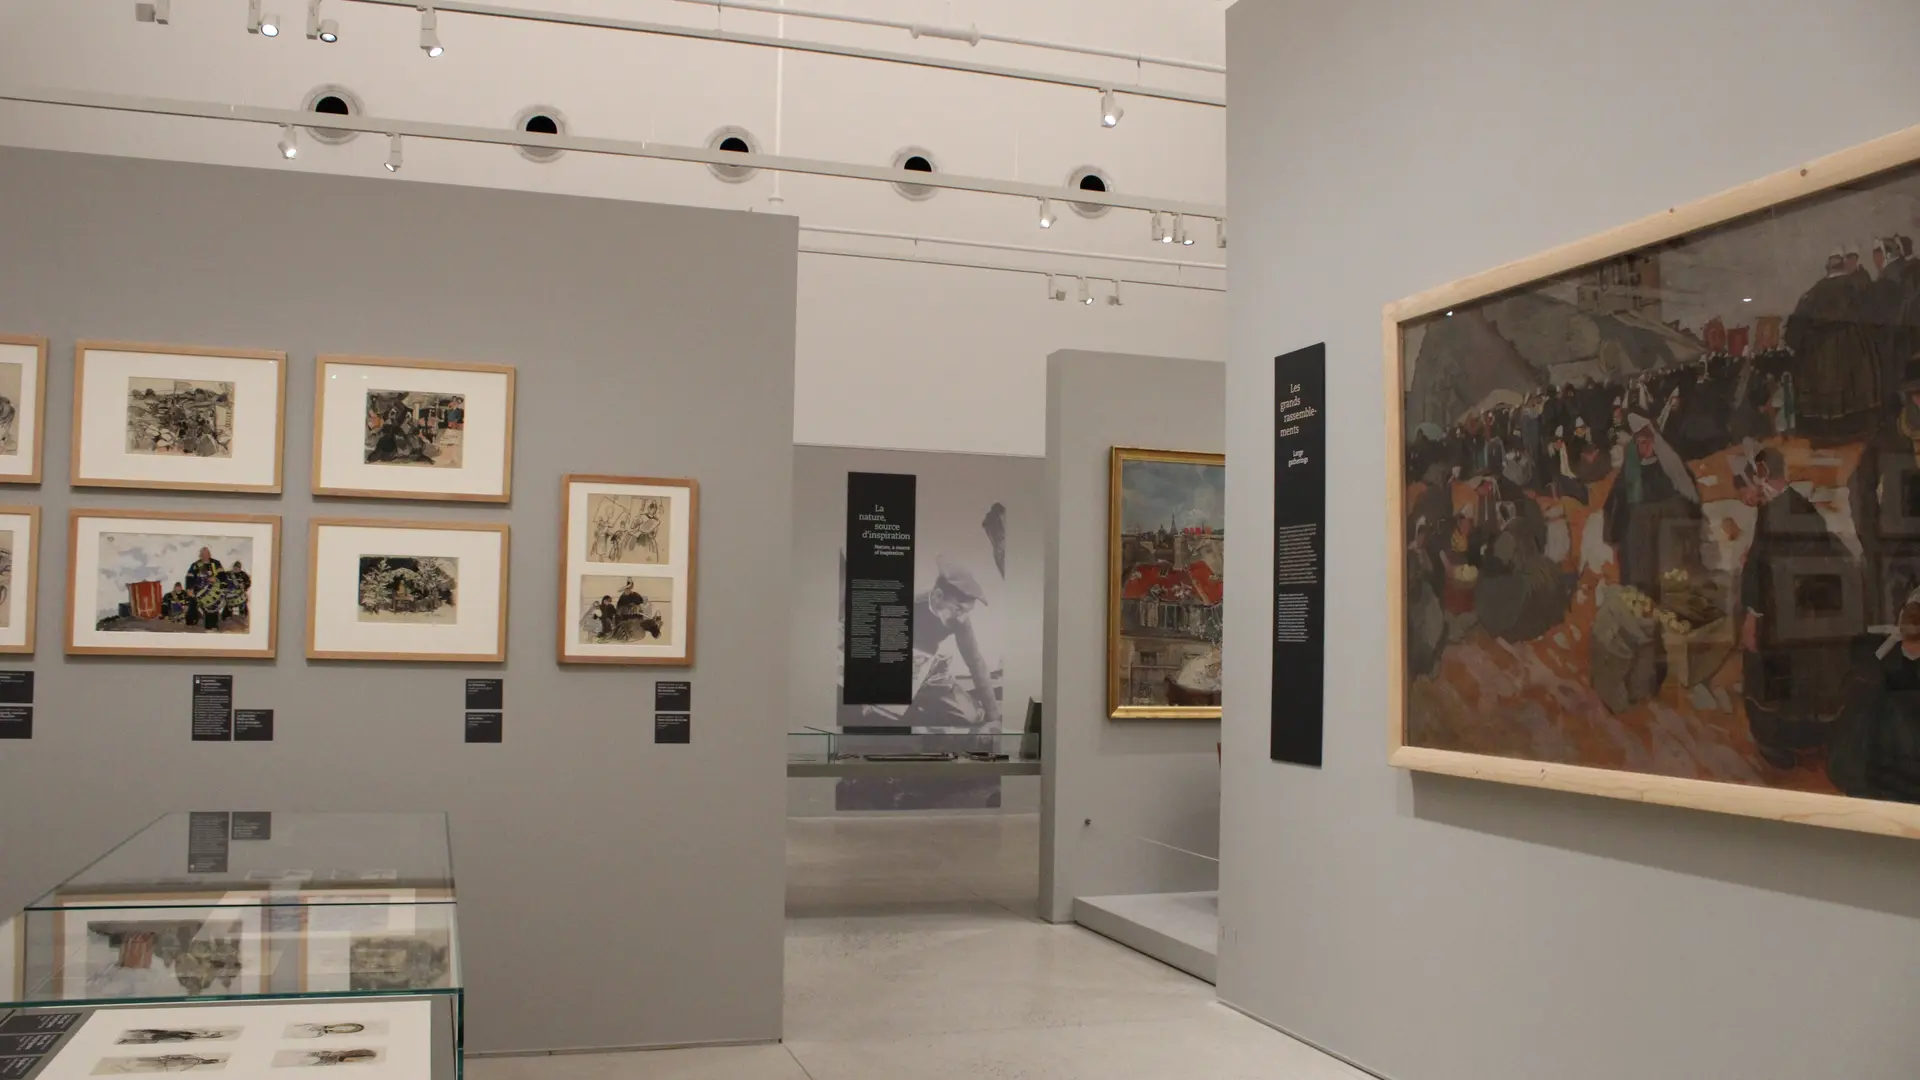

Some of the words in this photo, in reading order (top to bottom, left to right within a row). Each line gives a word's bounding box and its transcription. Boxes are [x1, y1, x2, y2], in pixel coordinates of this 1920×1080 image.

[1290, 383, 1301, 393] Les
[1280, 396, 1301, 412] grands
[1283, 406, 1317, 422] rassemble-
[1280, 425, 1299, 437] ments
[875, 504, 884, 512] La
[858, 514, 886, 522] nature,
[861, 530, 911, 541] d'inspiration
